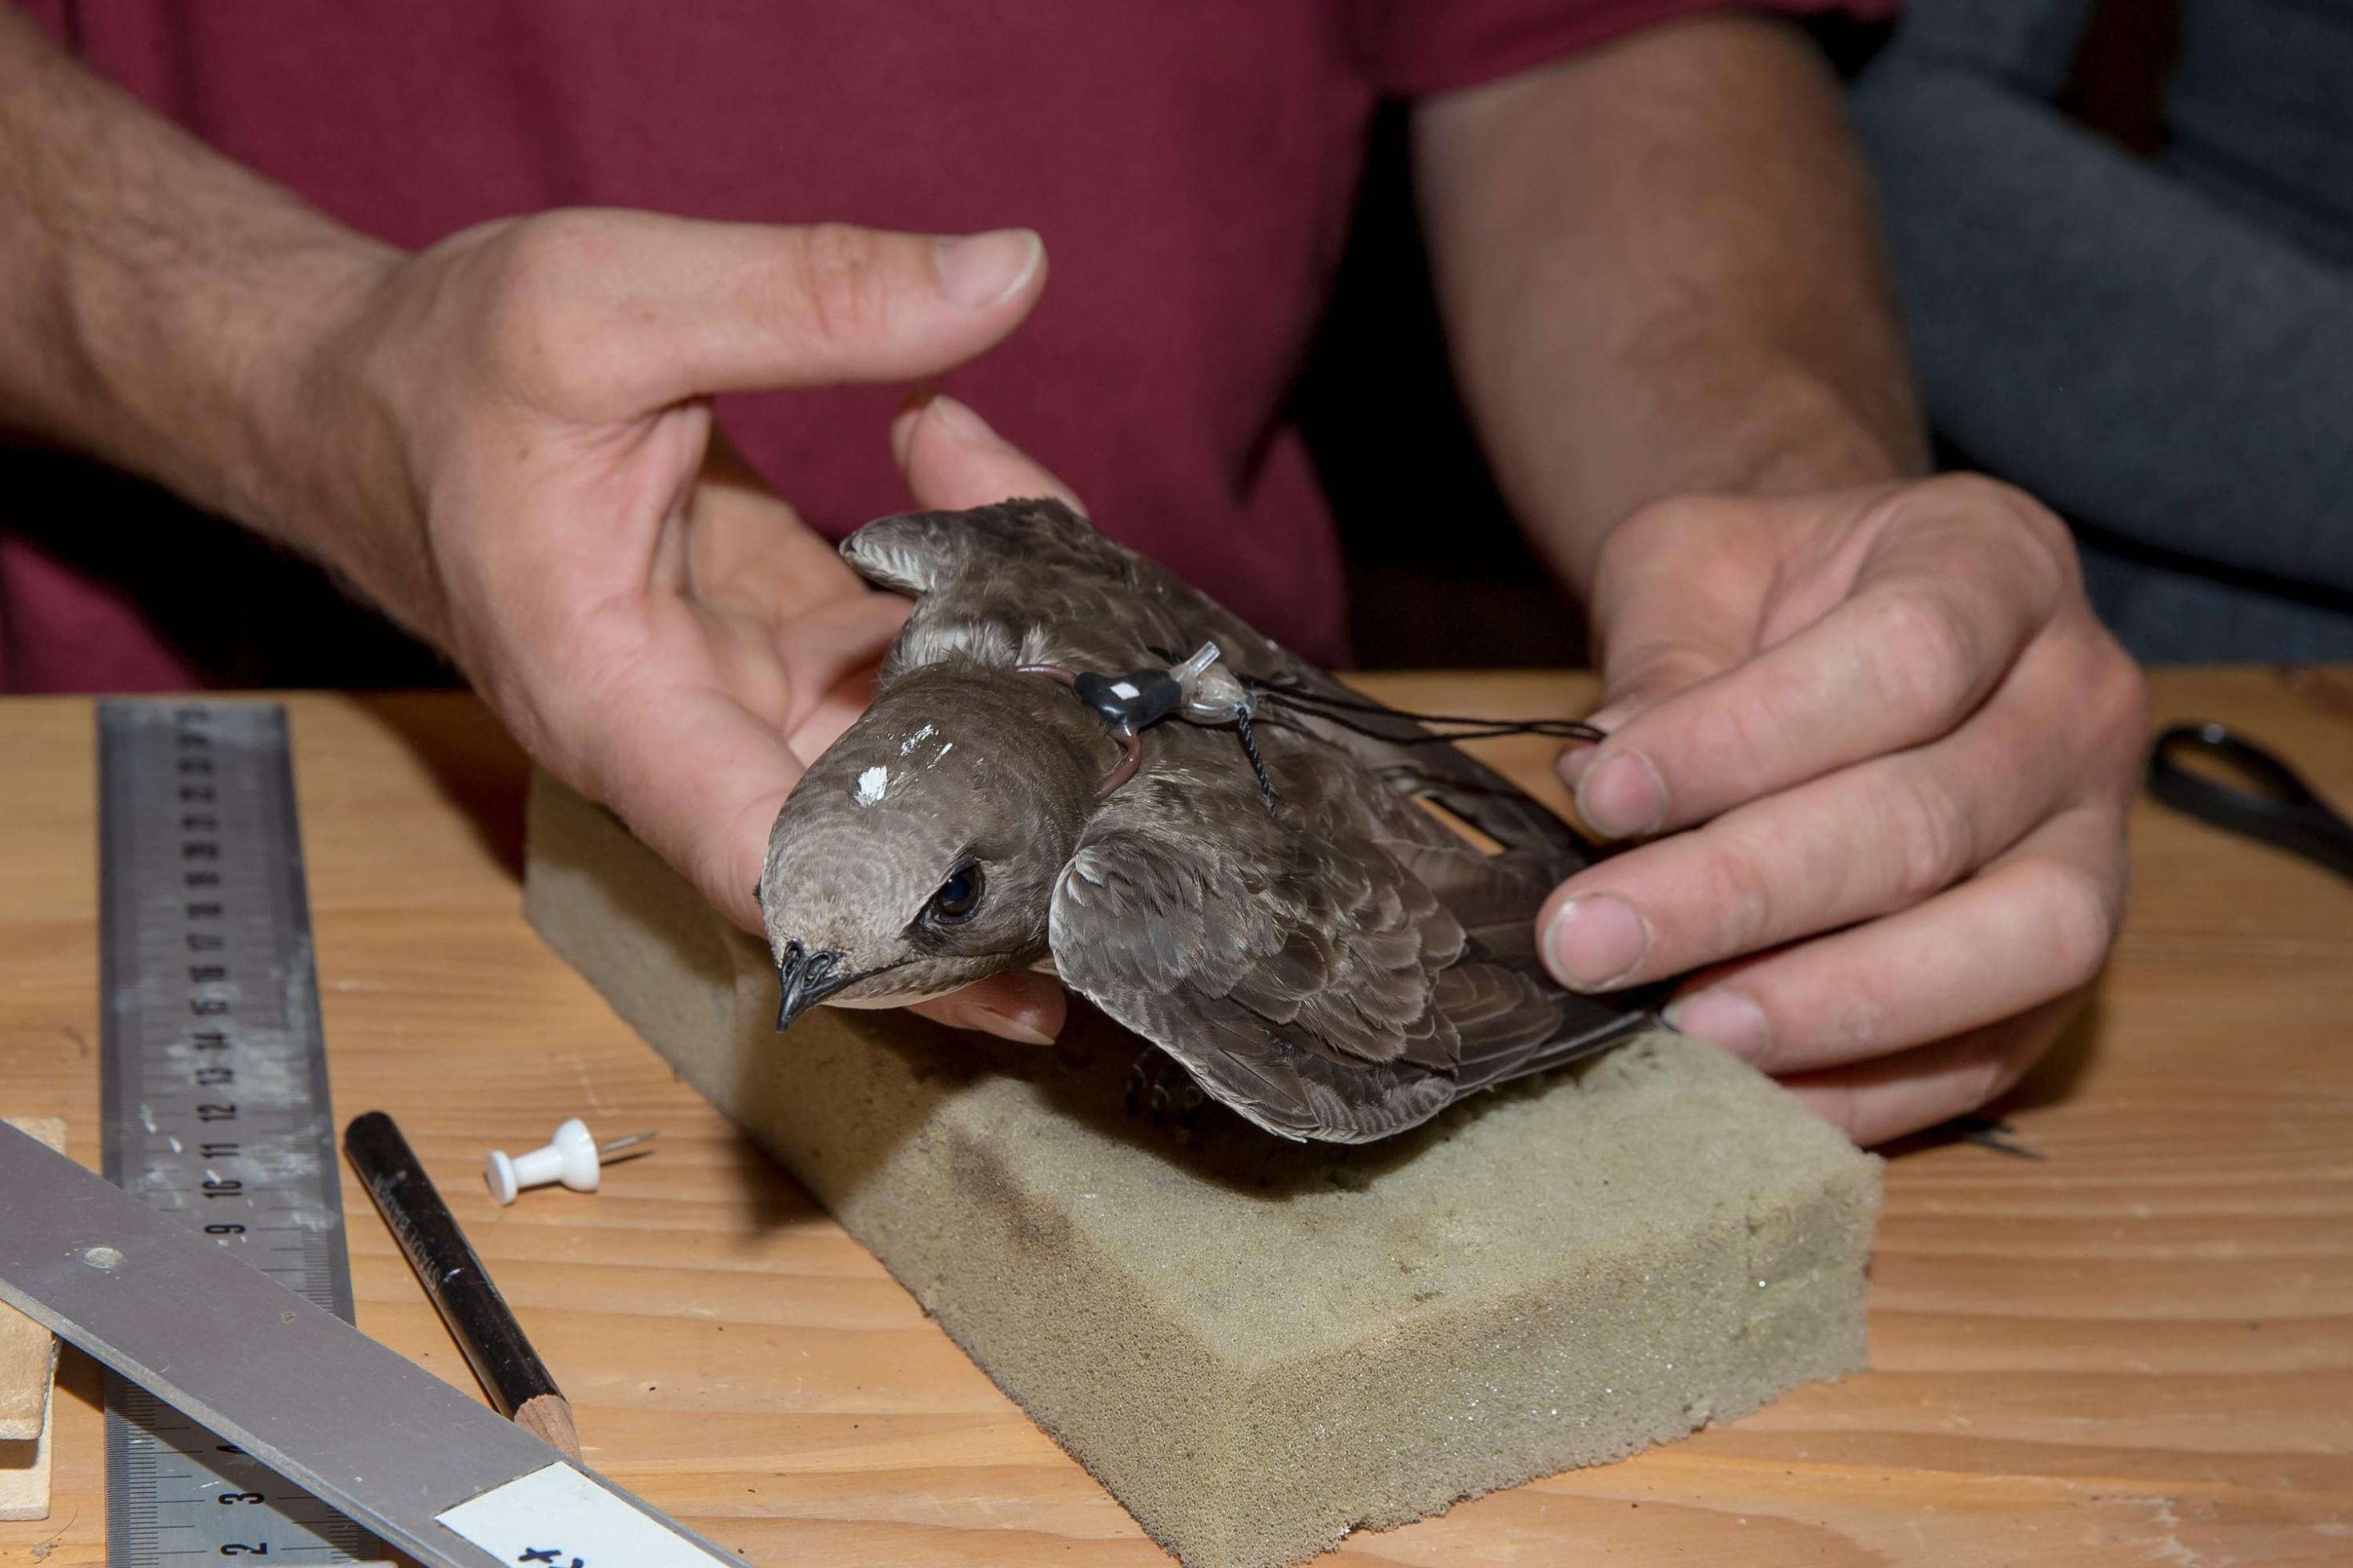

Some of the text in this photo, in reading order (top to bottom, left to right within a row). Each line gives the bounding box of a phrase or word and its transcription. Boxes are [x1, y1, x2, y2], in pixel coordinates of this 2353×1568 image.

[194, 1032, 230, 1049] 14
[195, 1067, 233, 1085] 13
[196, 1103, 236, 1122] 12
[199, 1143, 239, 1158] 11
[202, 1180, 243, 1199] 10
[204, 1225, 245, 1234] 9
[218, 1492, 265, 1505] 3
[220, 1542, 267, 1556] 2
